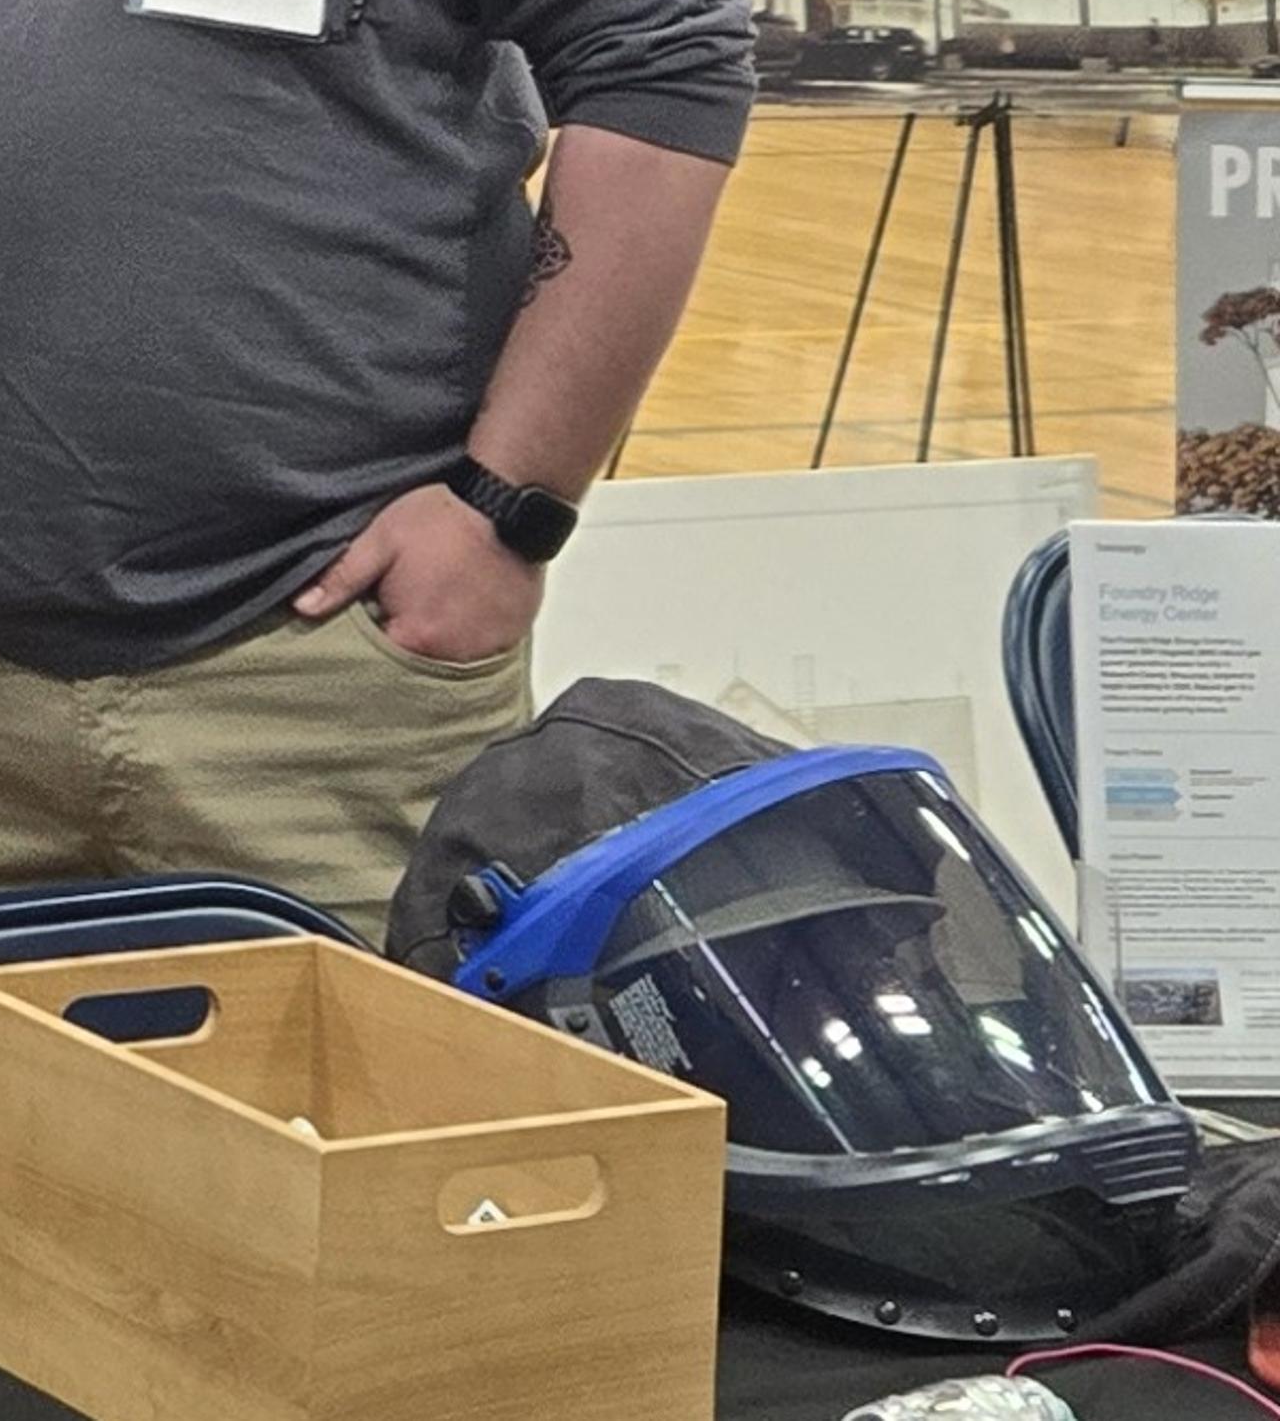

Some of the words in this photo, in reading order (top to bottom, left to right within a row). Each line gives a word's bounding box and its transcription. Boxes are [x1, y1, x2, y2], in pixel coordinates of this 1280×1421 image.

[1098, 582, 1167, 604] Foundry
[1171, 584, 1220, 604] Ridge
[1098, 603, 1159, 624] Energy
[1163, 604, 1218, 622] Center
